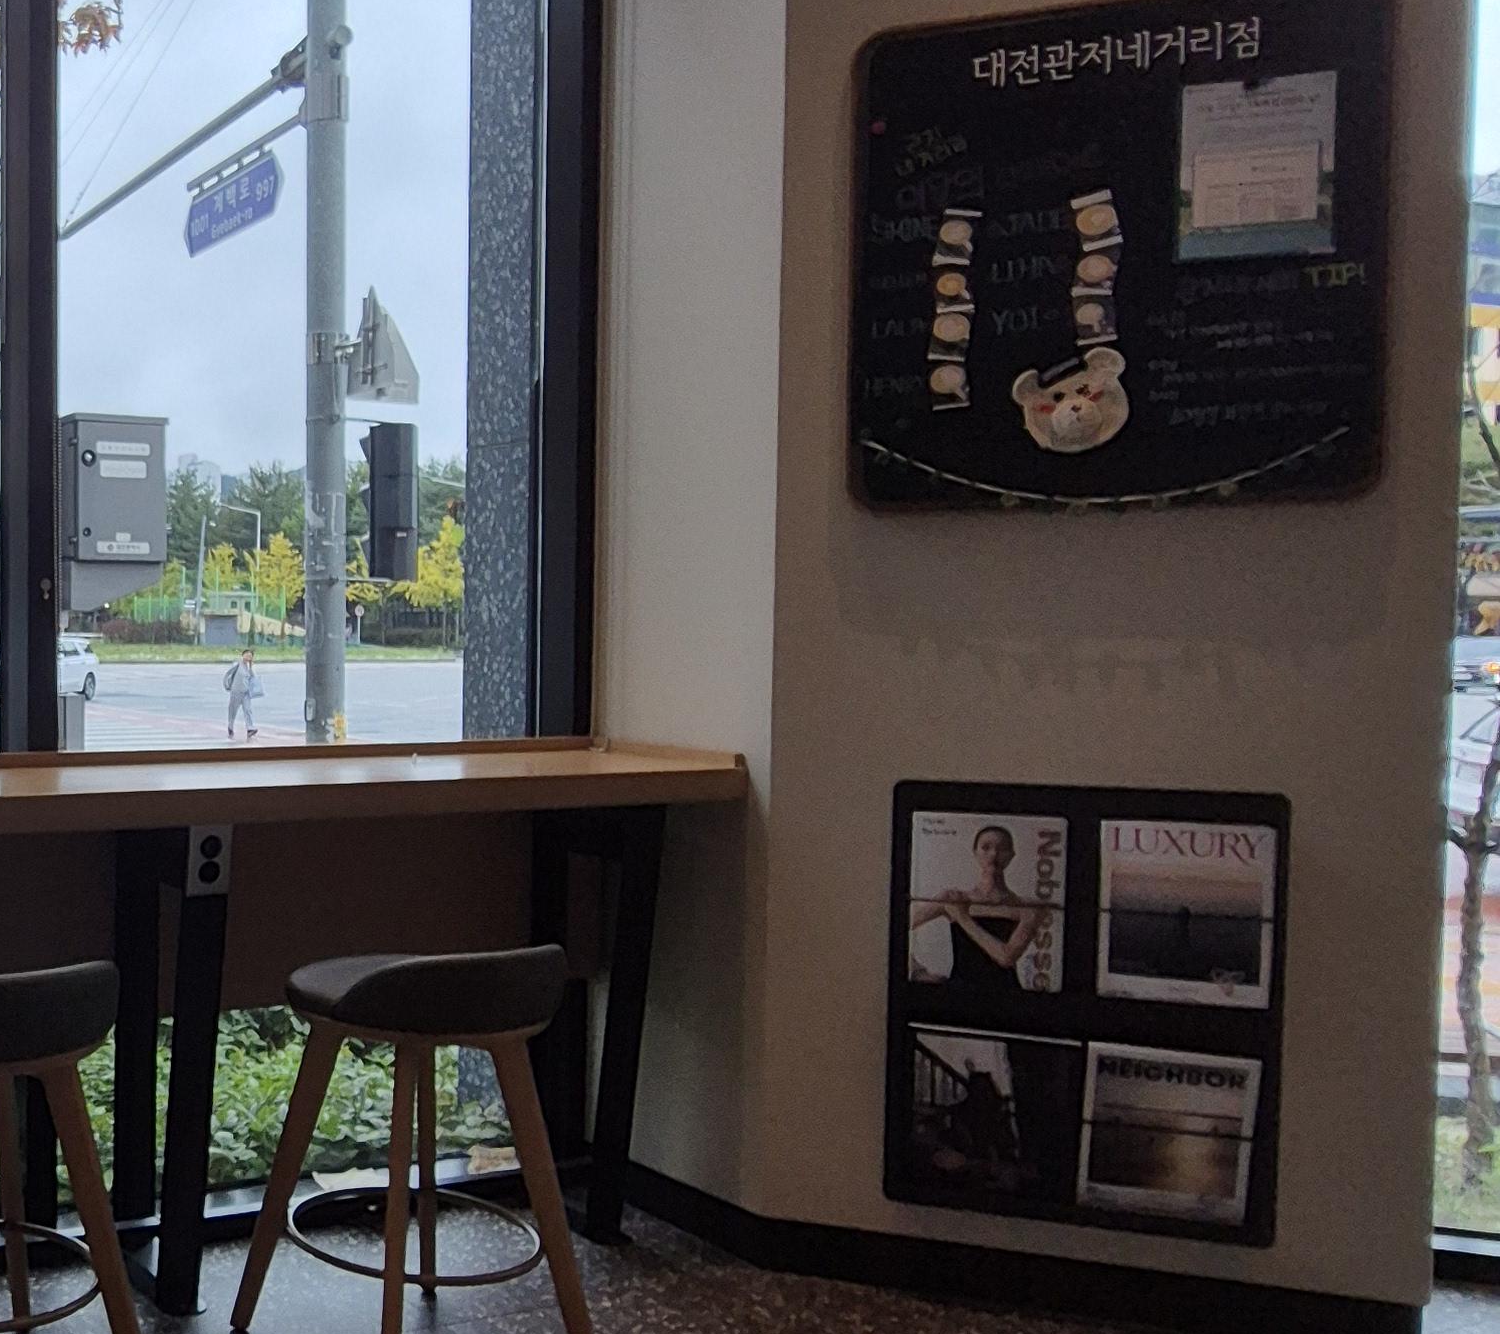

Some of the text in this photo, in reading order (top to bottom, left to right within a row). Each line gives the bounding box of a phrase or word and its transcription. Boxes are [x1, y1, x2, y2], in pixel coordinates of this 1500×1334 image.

[973, 16, 1264, 89] 대전관저네거리점
[213, 177, 251, 214] 계백로
[256, 175, 275, 202] 997
[191, 213, 209, 237] 1001
[1304, 262, 1367, 288] TIP!
[1110, 825, 1266, 866] LUXURY
[1098, 1056, 1247, 1091] NEIGHBOR
